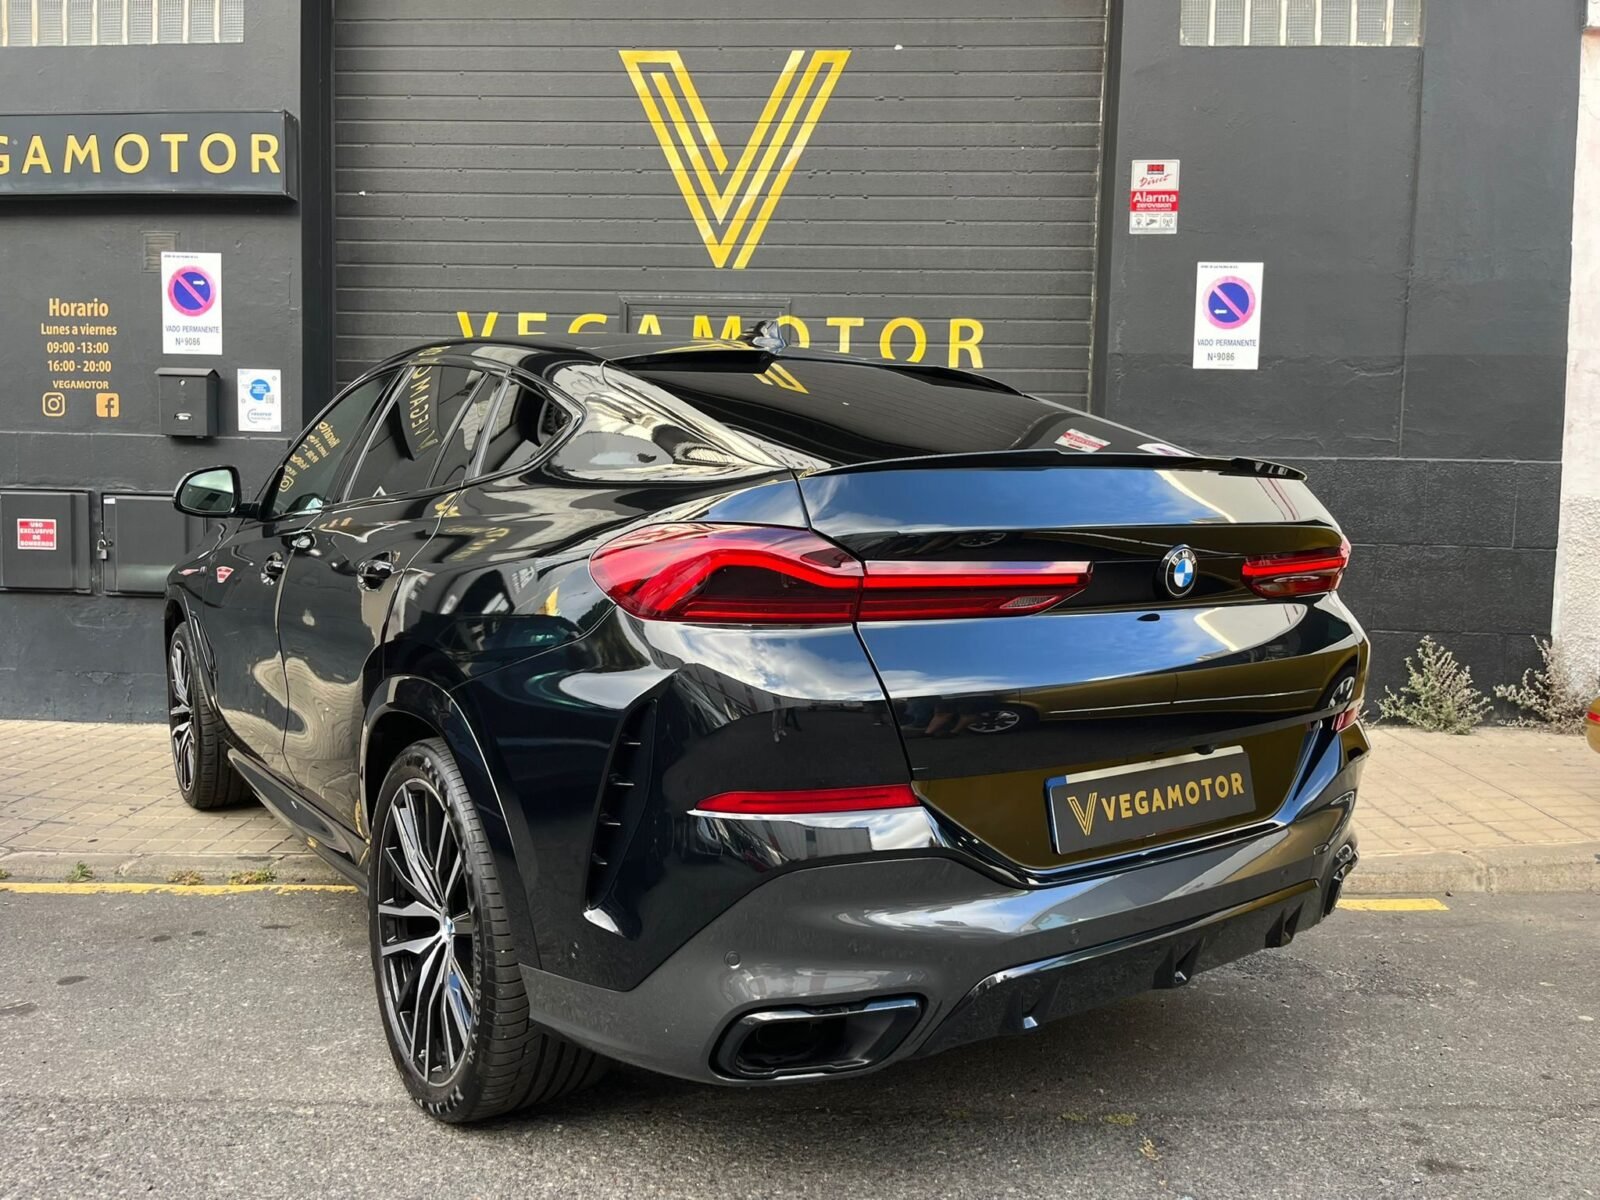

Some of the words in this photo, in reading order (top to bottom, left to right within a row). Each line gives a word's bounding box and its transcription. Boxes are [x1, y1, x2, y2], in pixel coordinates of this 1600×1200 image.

[1133, 191, 1176, 202] Alarma
[49, 298, 109, 317] Horario
[41, 322, 70, 335] Lunes
[71, 325, 78, 335] a
[80, 322, 118, 336] viernes
[165, 325, 180, 333] VADO
[182, 325, 220, 333] PERMANENTE
[46, 341, 75, 353] 09:00
[1216, 339, 1257, 347] PERMANENTE
[47, 359, 76, 372] 16:00
[83, 360, 112, 372] 20:00
[52, 380, 109, 389] VEGAMOTOR
[1101, 772, 1245, 822] VEGAMOTOR
